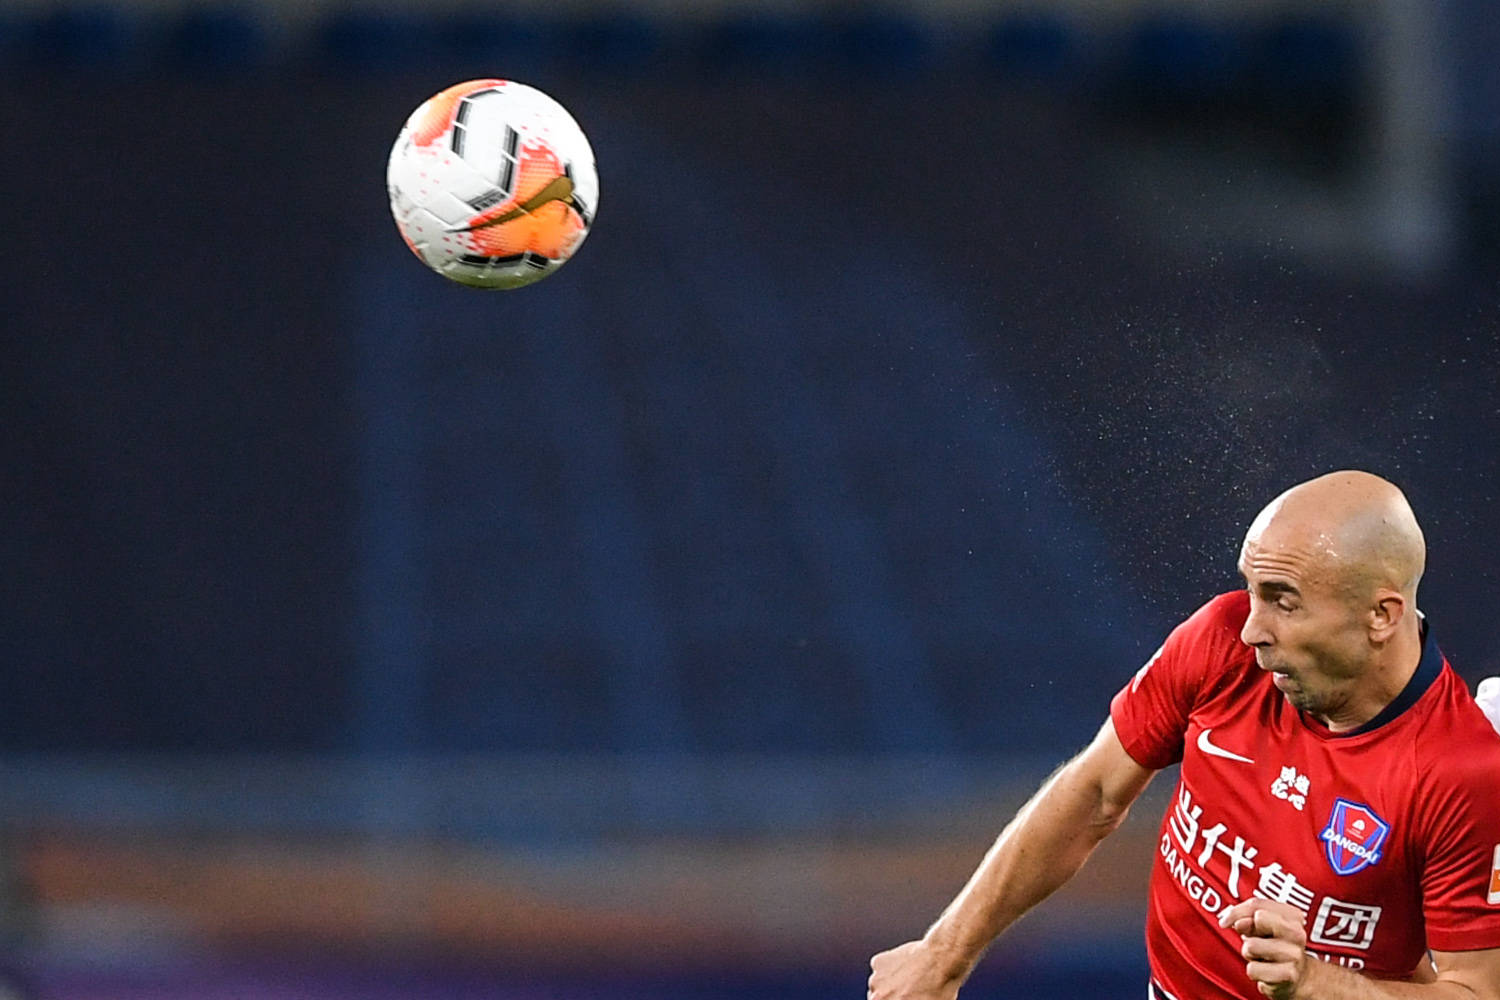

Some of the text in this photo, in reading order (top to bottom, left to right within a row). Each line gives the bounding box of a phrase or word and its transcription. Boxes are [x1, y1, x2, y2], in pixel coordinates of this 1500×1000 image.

[1169, 780, 1383, 950] 当代集团
[1322, 828, 1379, 863] DANGDAI
